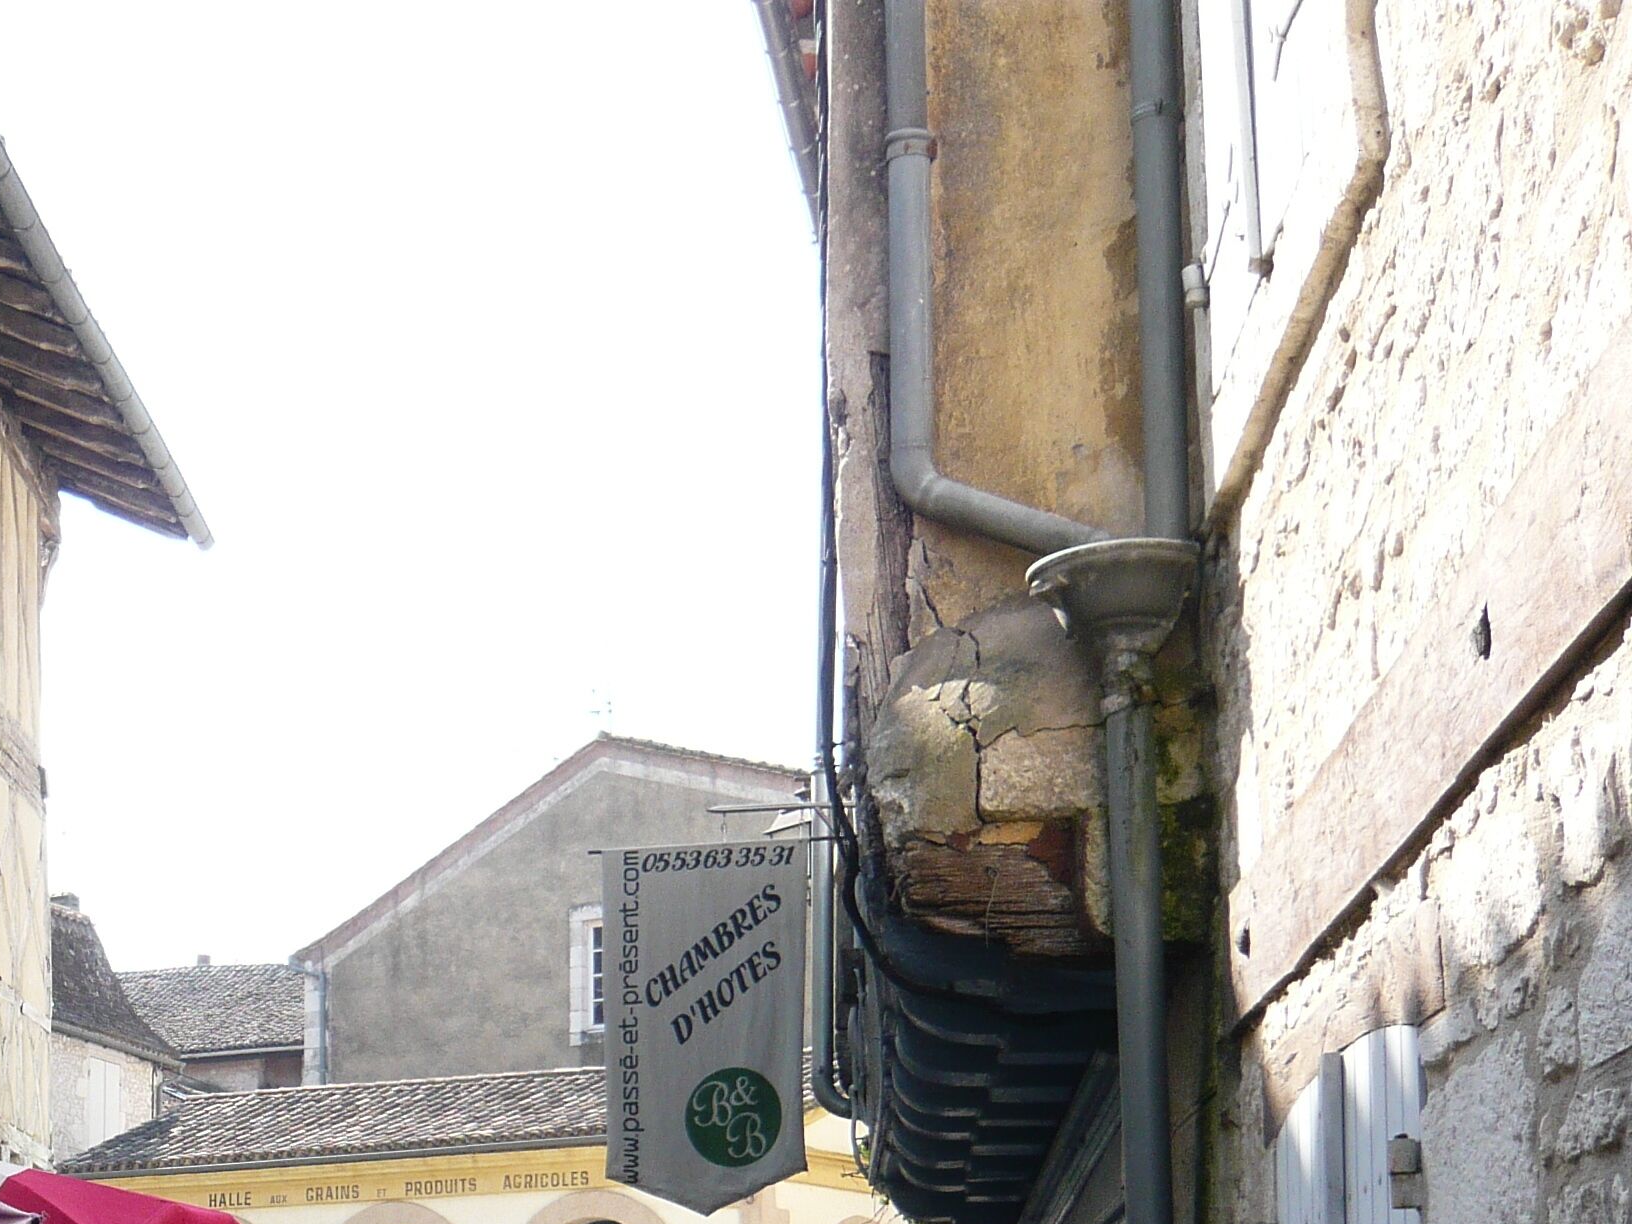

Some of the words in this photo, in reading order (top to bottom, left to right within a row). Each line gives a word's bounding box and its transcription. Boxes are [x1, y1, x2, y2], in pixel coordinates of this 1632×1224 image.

[645, 884, 782, 1008] CHAMBRES
[671, 941, 782, 1045] D'HOTES
[208, 1191, 252, 1207] HALLE
[269, 1194, 288, 1204] AUX
[306, 1184, 360, 1201] GRAINS
[376, 1188, 387, 1198] ET
[405, 1177, 477, 1196] PRODUITS
[503, 1171, 589, 1190] AGRICOLES
